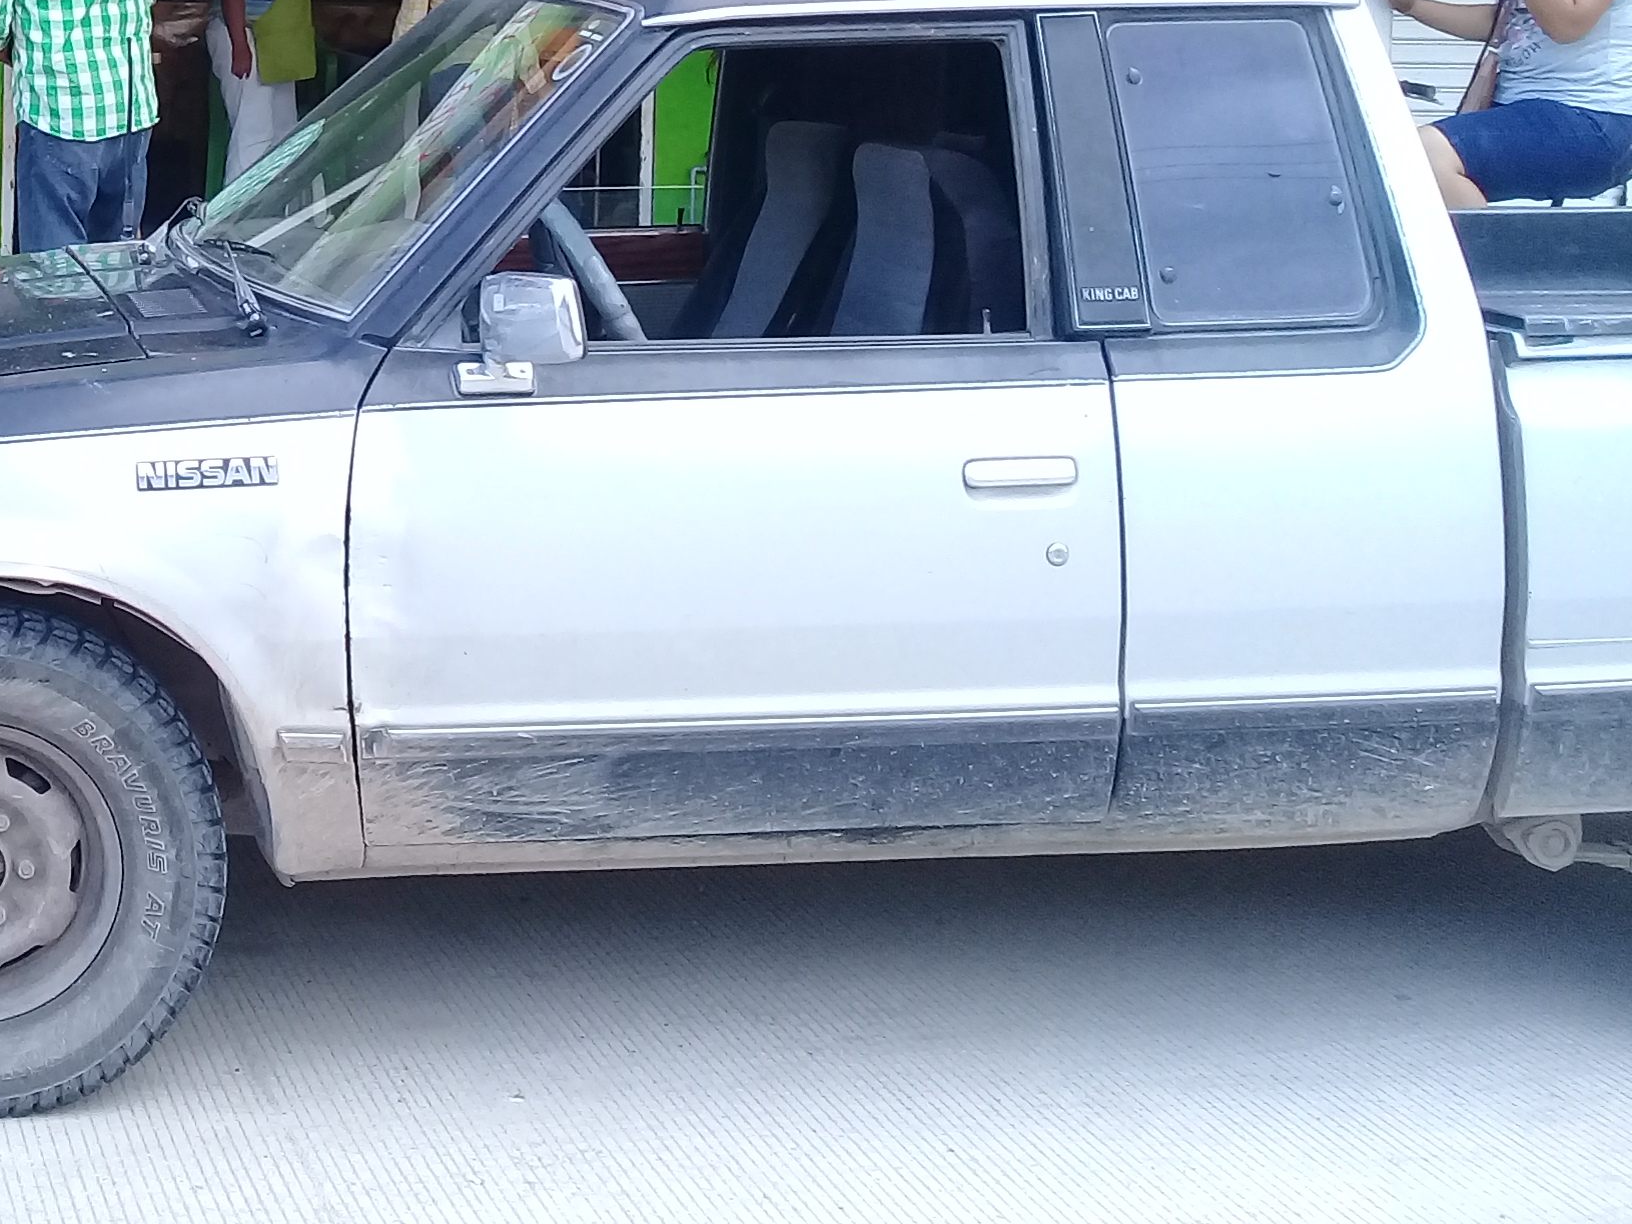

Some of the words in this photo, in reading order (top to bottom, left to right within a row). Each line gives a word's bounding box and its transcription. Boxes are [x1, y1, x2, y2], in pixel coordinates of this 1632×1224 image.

[1081, 286, 1113, 302] KING
[1114, 285, 1139, 301] CAB
[135, 455, 279, 492] NISSAN
[71, 719, 168, 875] BRAVURIS
[140, 891, 166, 944] AT
